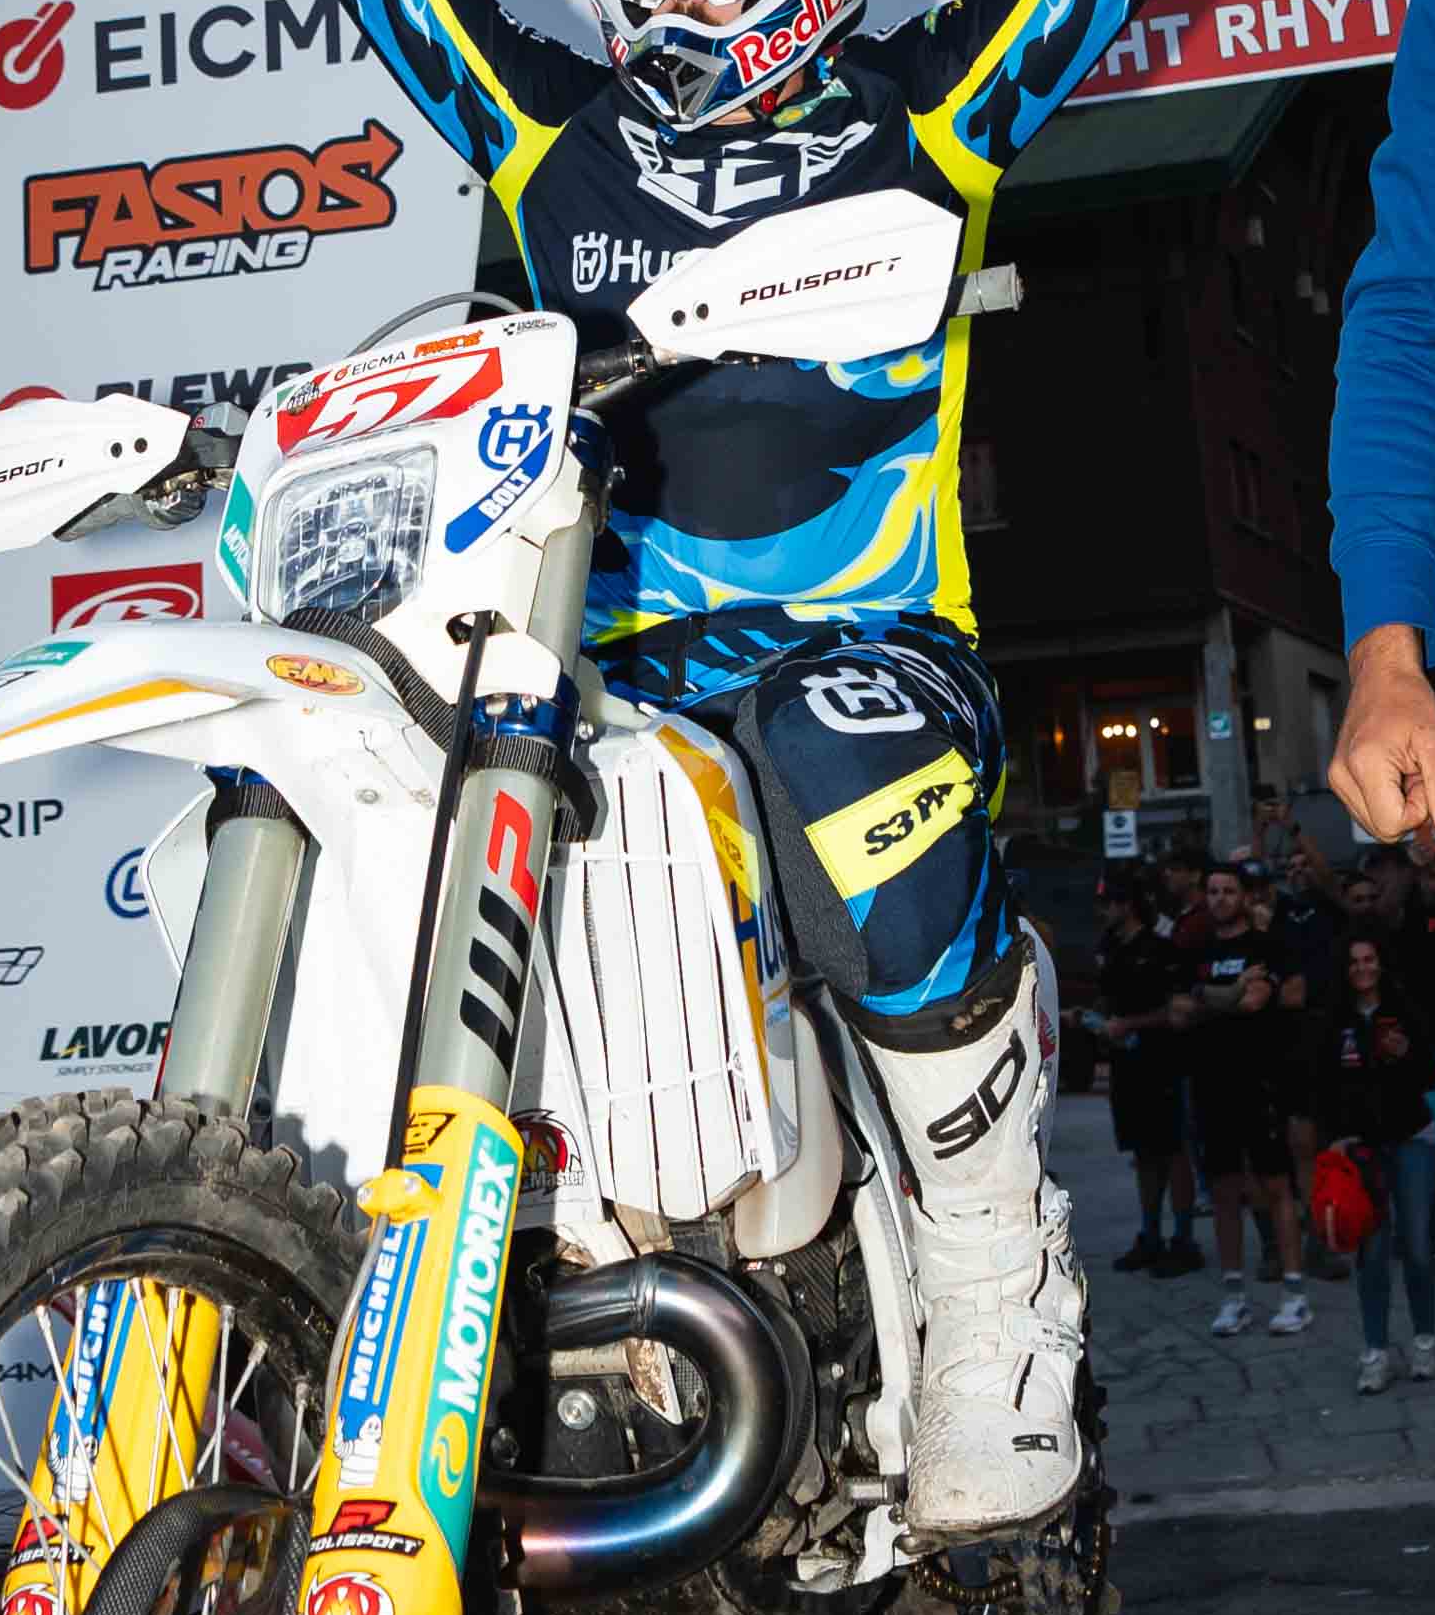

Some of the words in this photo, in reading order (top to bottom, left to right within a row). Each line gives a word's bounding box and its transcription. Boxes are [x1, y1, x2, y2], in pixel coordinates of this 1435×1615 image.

[1087, 12, 1190, 80] HT
[24, 119, 404, 275] FASTOS
[93, 232, 313, 293] RACING
[352, 350, 406, 377] EICMA
[479, 468, 532, 521] BOLT
[863, 809, 916, 857] S3
[348, 1223, 404, 1402] MICHEL
[438, 1153, 515, 1414] MOTOREX
